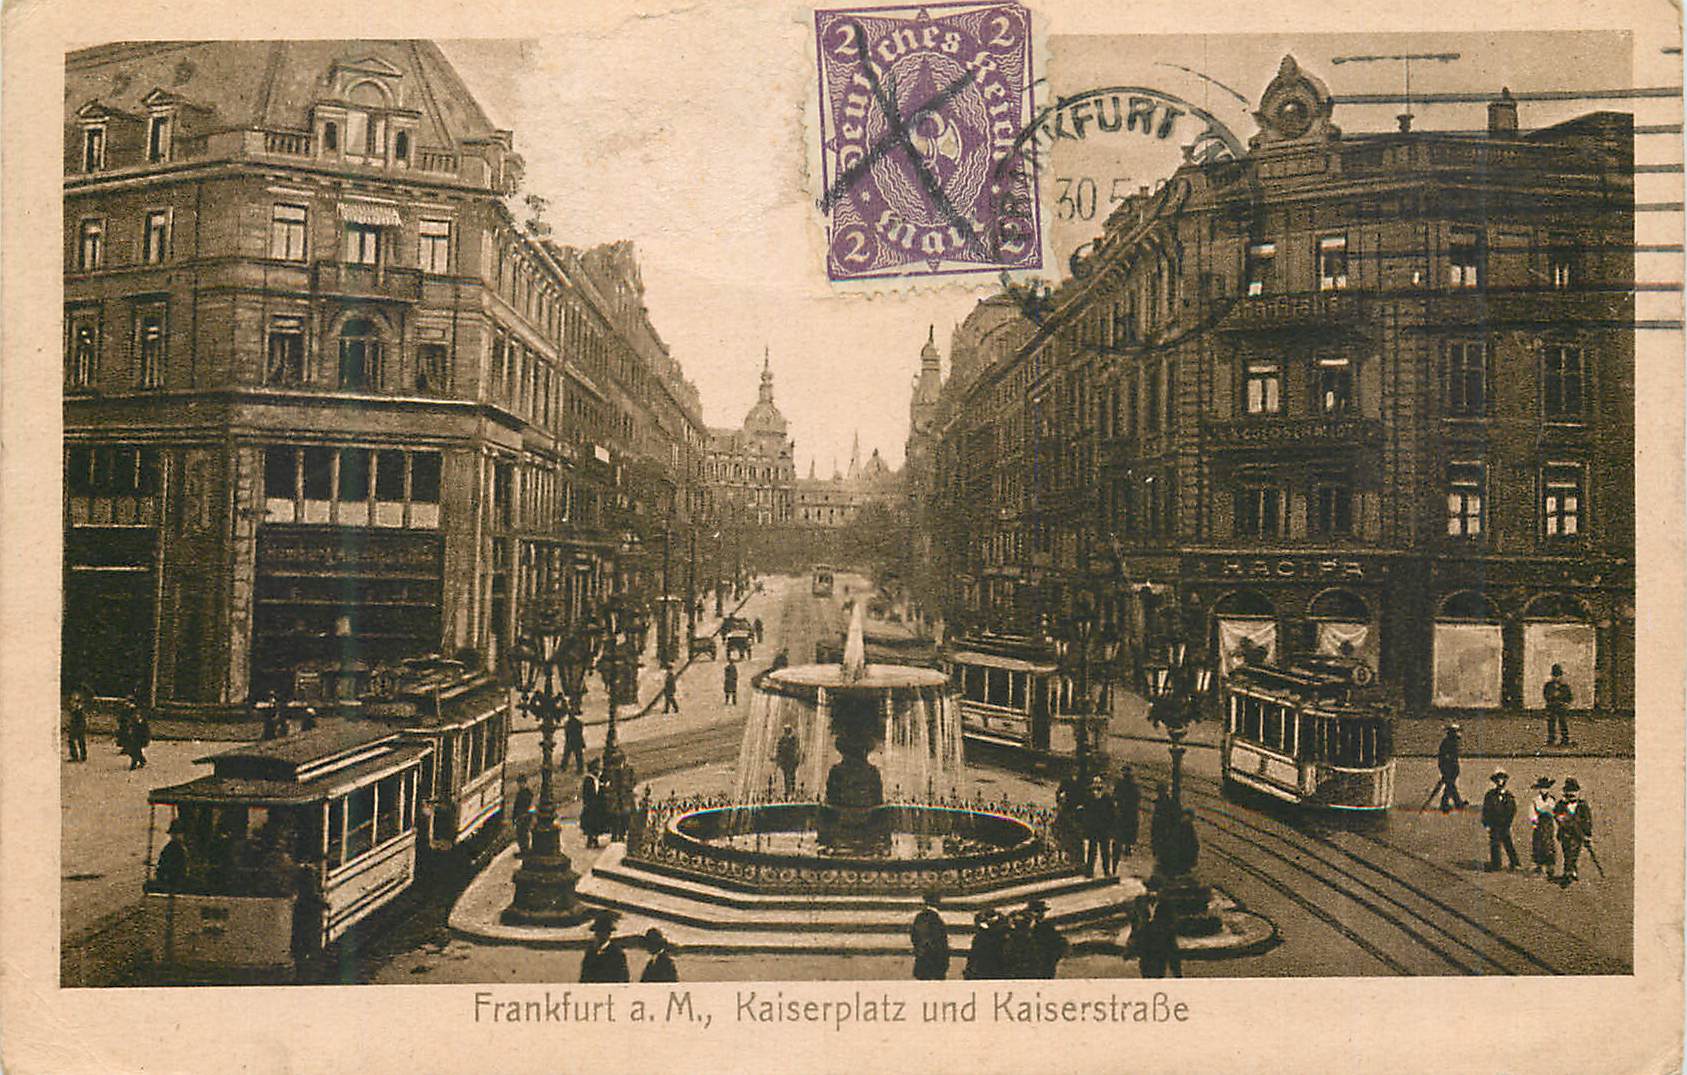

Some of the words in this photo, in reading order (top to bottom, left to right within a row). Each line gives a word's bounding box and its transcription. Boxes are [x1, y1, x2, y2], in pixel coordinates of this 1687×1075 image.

[835, 24, 859, 55] 2
[987, 16, 1015, 47] 2
[1055, 177, 1097, 221] 30
[844, 230, 871, 264] 2
